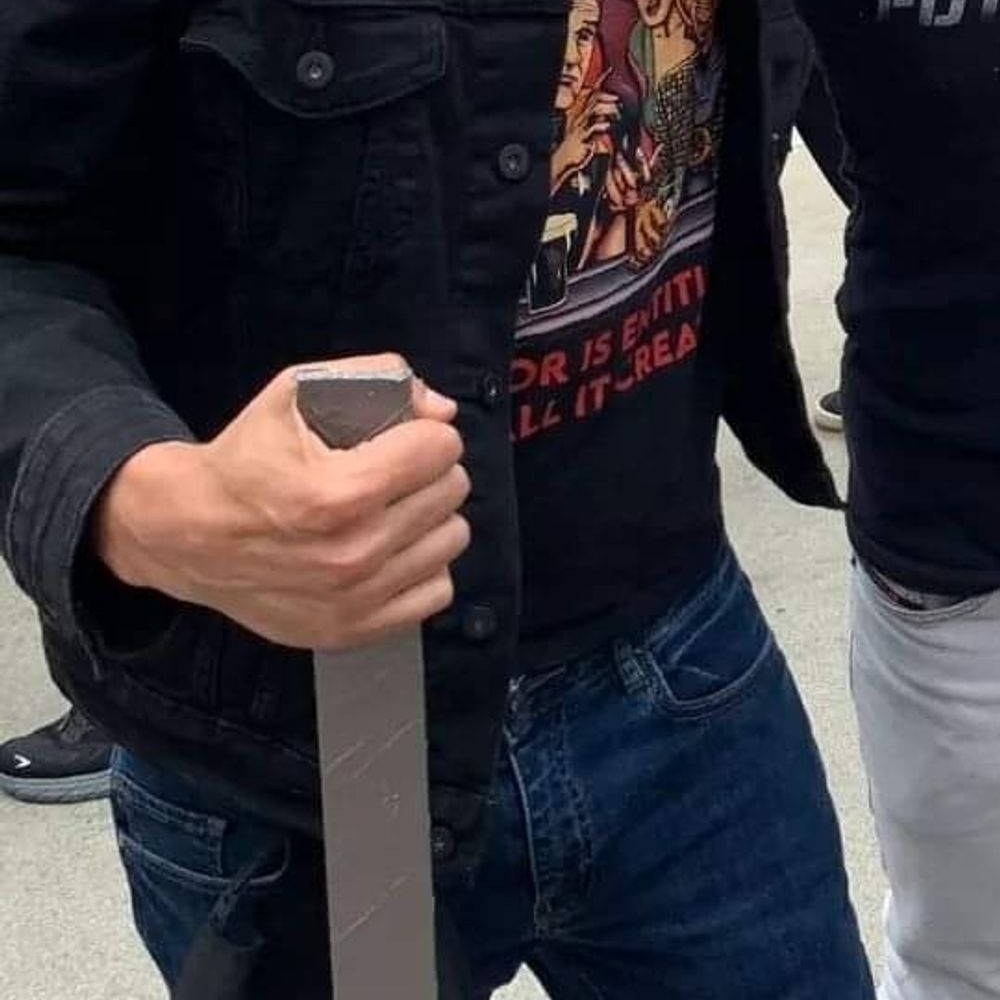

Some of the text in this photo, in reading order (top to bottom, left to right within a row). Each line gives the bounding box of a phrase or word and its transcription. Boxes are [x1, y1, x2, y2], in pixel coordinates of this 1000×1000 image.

[580, 330, 613, 372] IS
[510, 399, 563, 441] LL
[574, 372, 612, 419] IT
